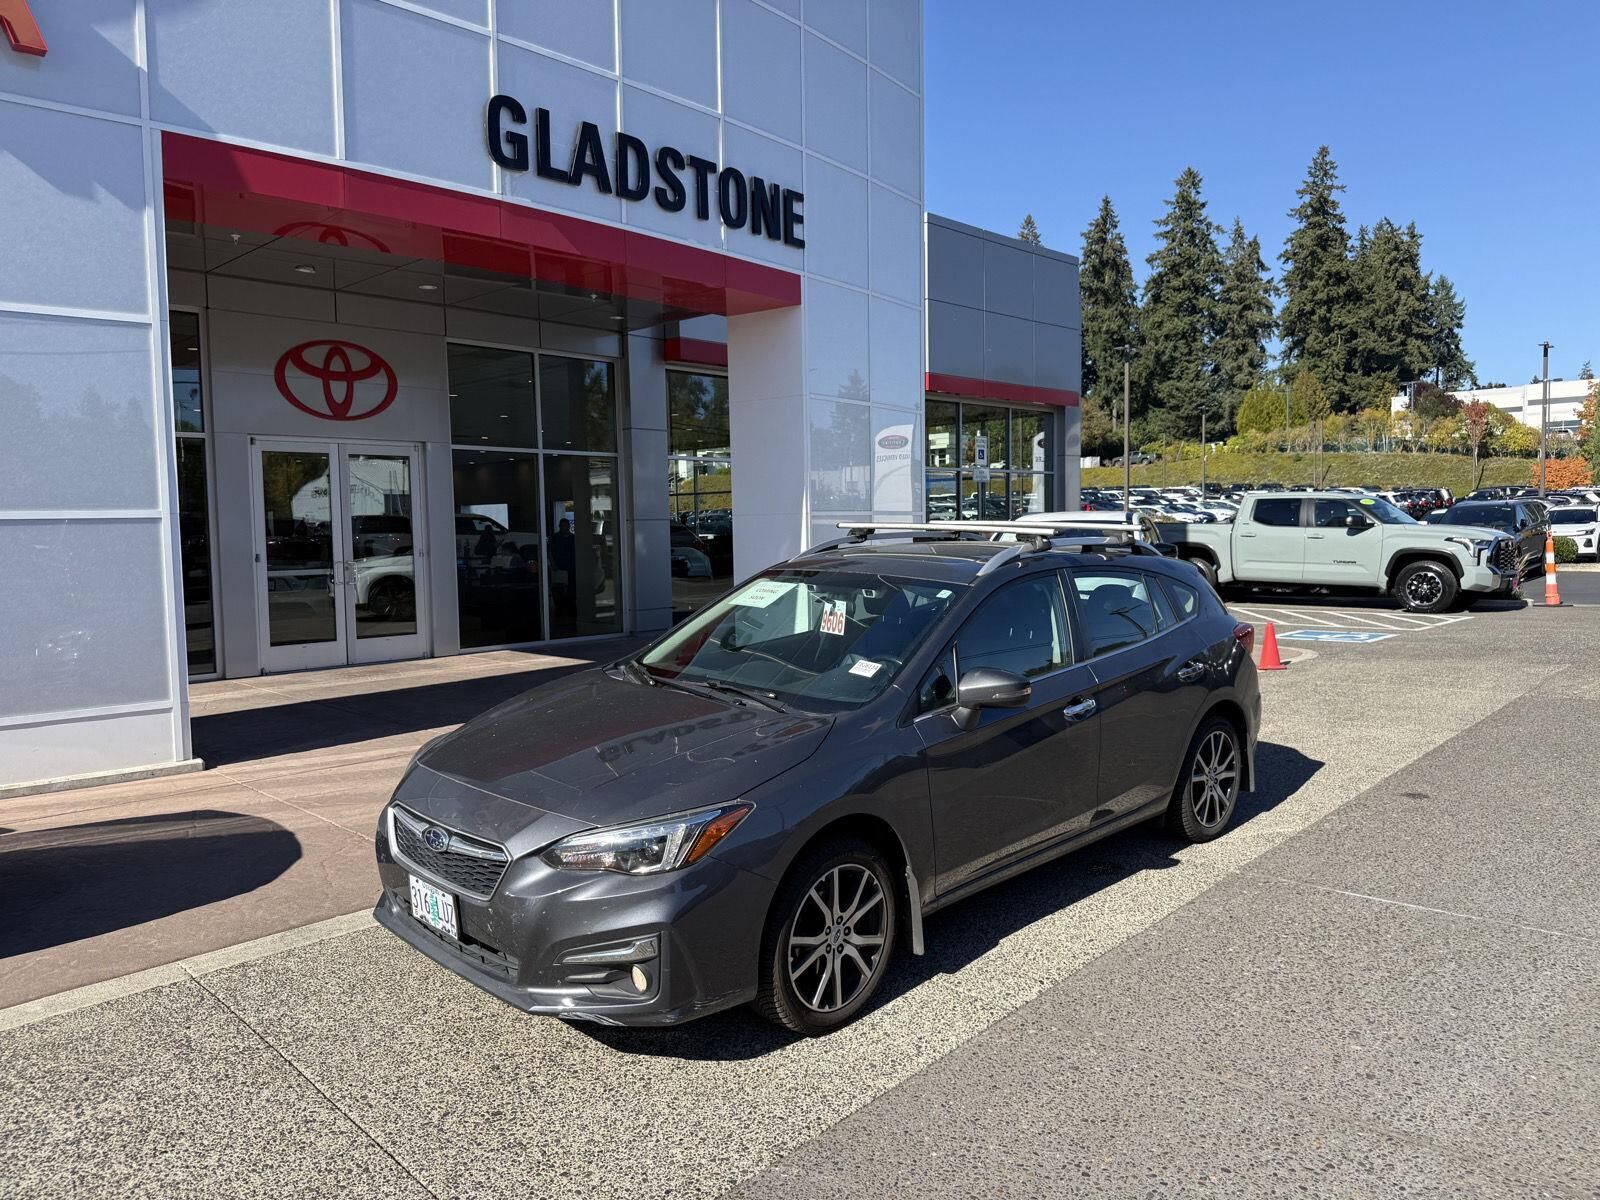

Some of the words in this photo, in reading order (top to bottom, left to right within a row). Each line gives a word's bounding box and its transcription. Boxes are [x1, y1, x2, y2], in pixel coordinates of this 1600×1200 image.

[487, 94, 806, 249] GLADSTONE
[821, 610, 844, 634] 9606
[411, 885, 430, 914] 316
[435, 896, 456, 929] LUZ
